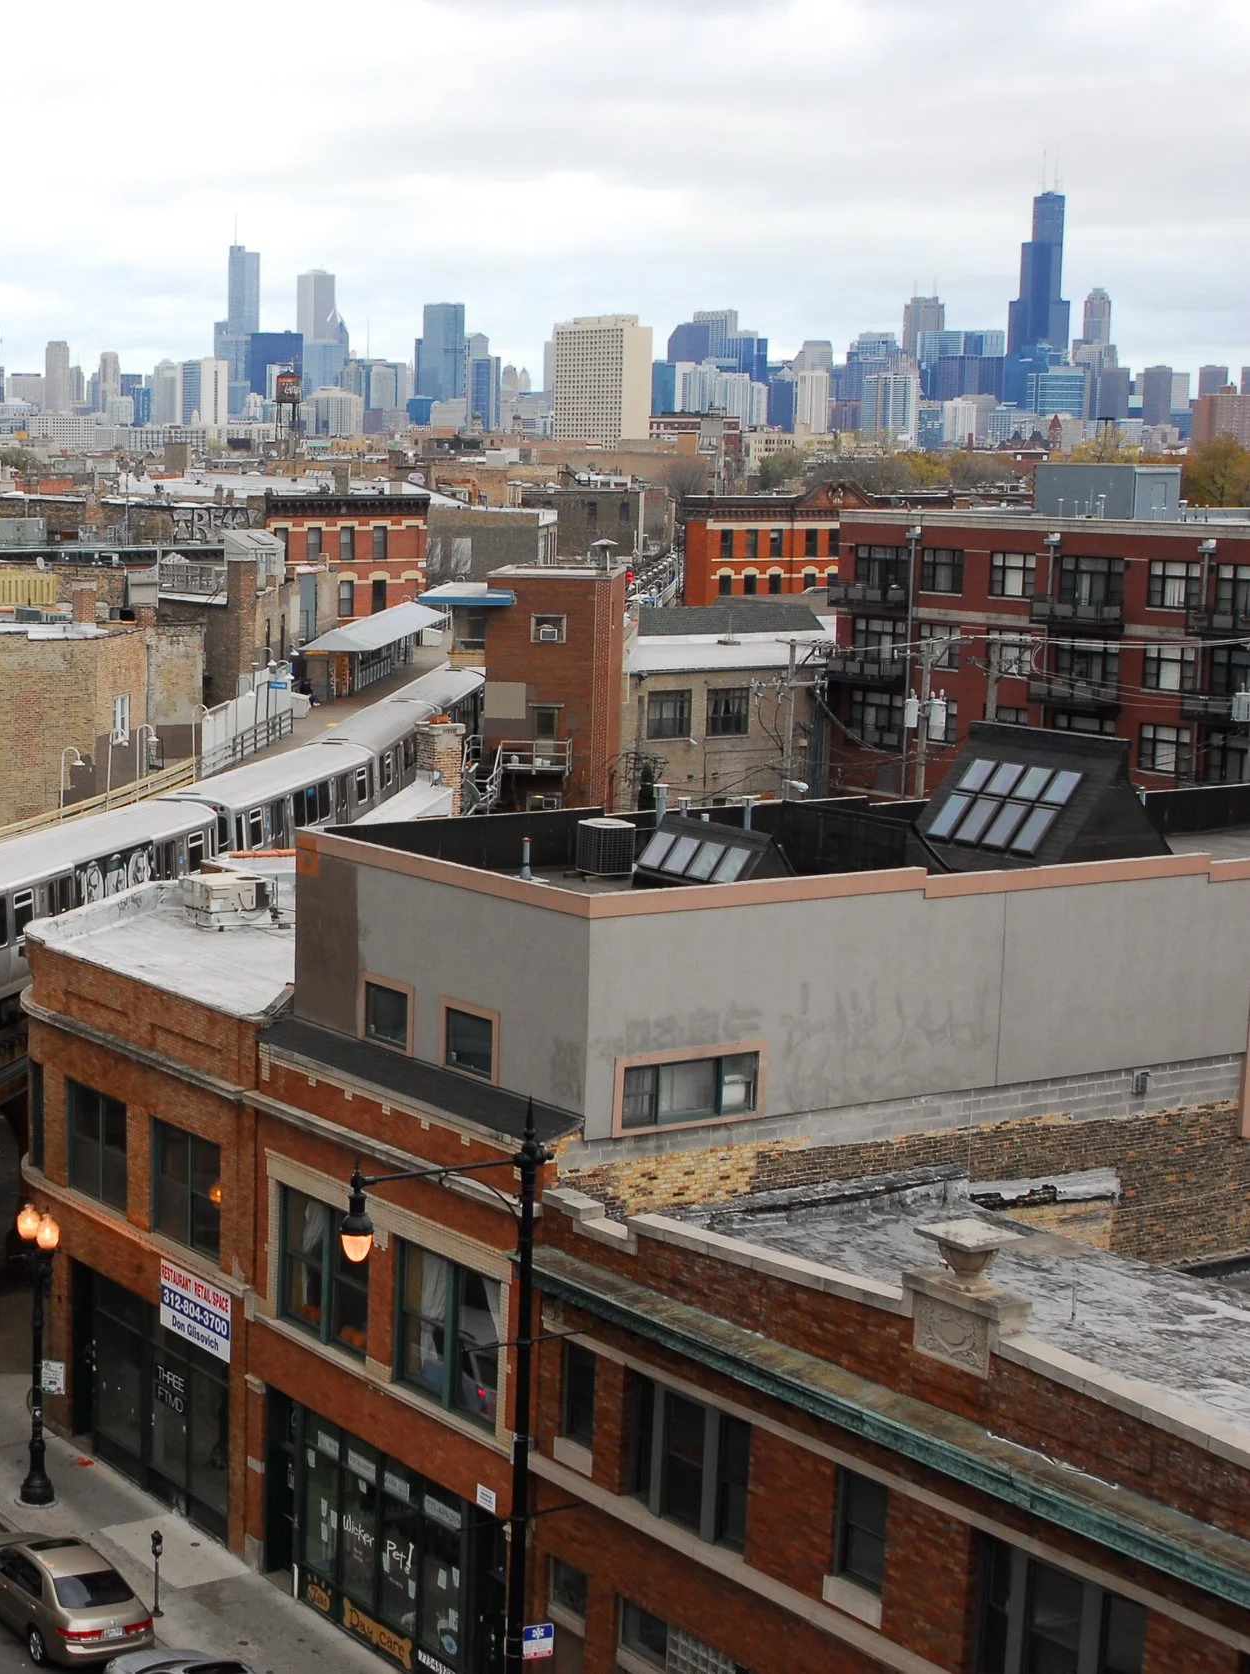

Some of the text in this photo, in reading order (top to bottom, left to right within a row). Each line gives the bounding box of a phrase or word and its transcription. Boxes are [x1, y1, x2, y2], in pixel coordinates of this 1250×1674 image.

[163, 1289, 227, 1336] 312-804-3700
[213, 1292, 228, 1313] SPACE
[171, 1314, 219, 1352] Don Glisovich
[157, 1365, 184, 1393] THREE
[343, 1514, 375, 1547] Wicker
[349, 1609, 374, 1640] Day
